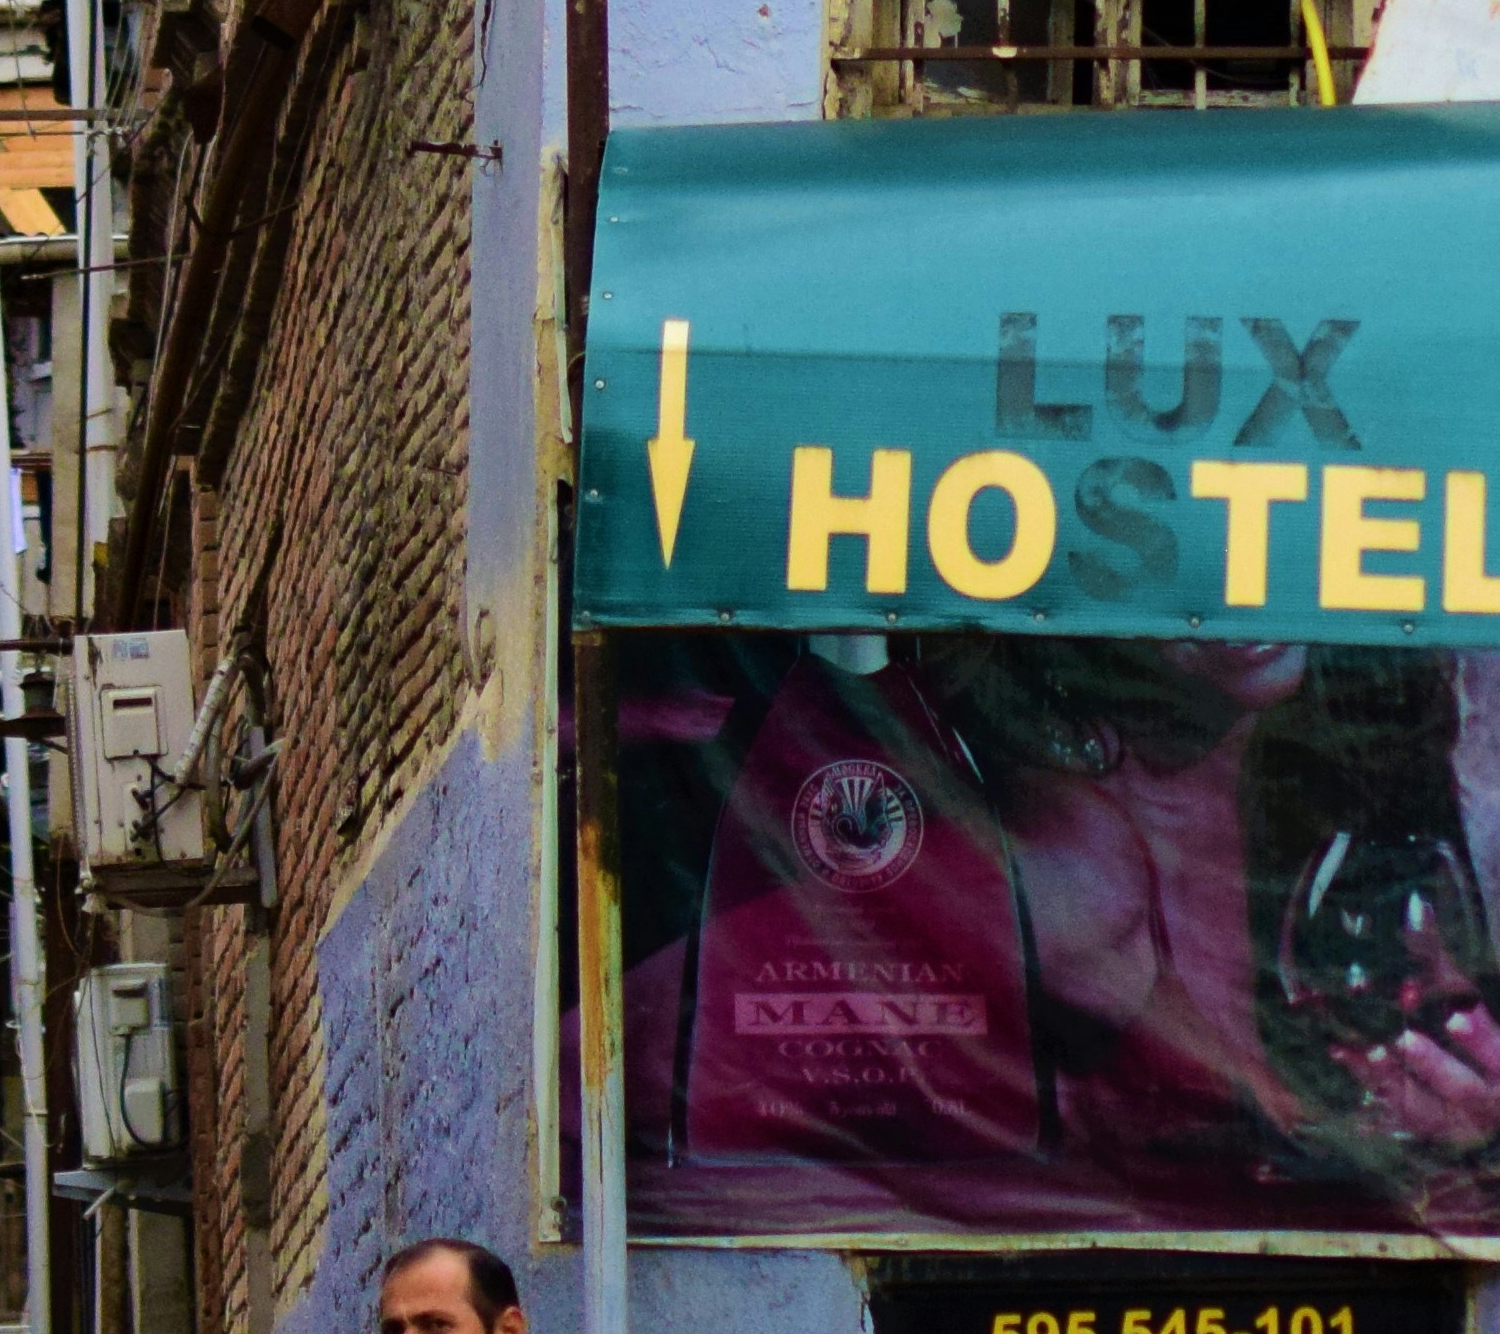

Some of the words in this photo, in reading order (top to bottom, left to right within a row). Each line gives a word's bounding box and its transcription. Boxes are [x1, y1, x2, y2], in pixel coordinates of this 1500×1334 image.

[995, 312, 1362, 450] LUX
[756, 961, 963, 982] ARMENIAN
[748, 998, 977, 1027] MANE
[778, 1039, 942, 1059] COGNAC
